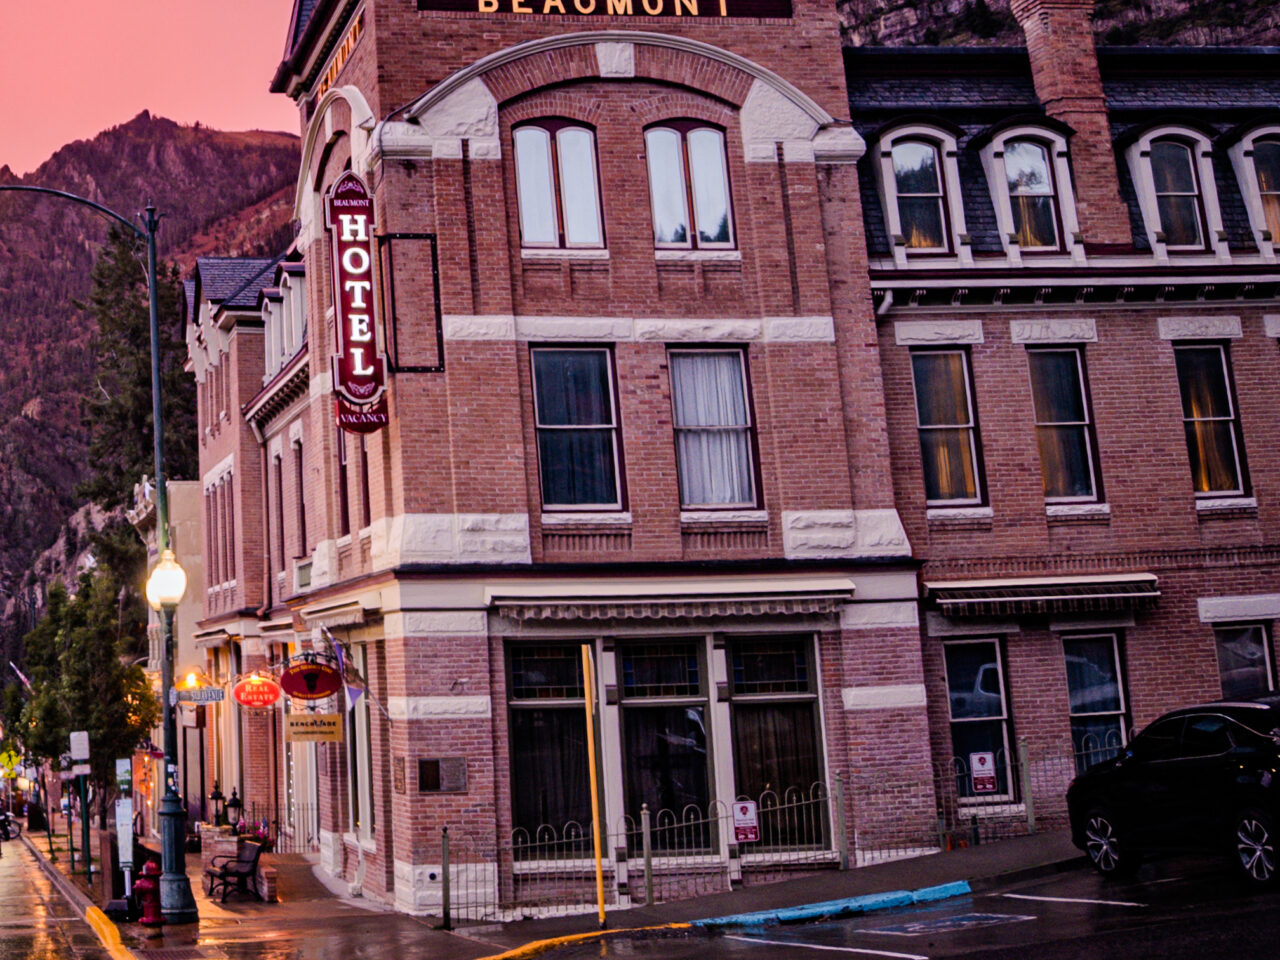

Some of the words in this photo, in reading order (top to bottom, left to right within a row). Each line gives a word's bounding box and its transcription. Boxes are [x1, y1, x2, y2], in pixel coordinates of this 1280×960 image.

[333, 199, 369, 207] BEAUMONT
[338, 214, 374, 376] HOTEL
[340, 413, 387, 424] VACANCY
[245, 684, 269, 692] REAL
[240, 692, 275, 701] ESTATE
